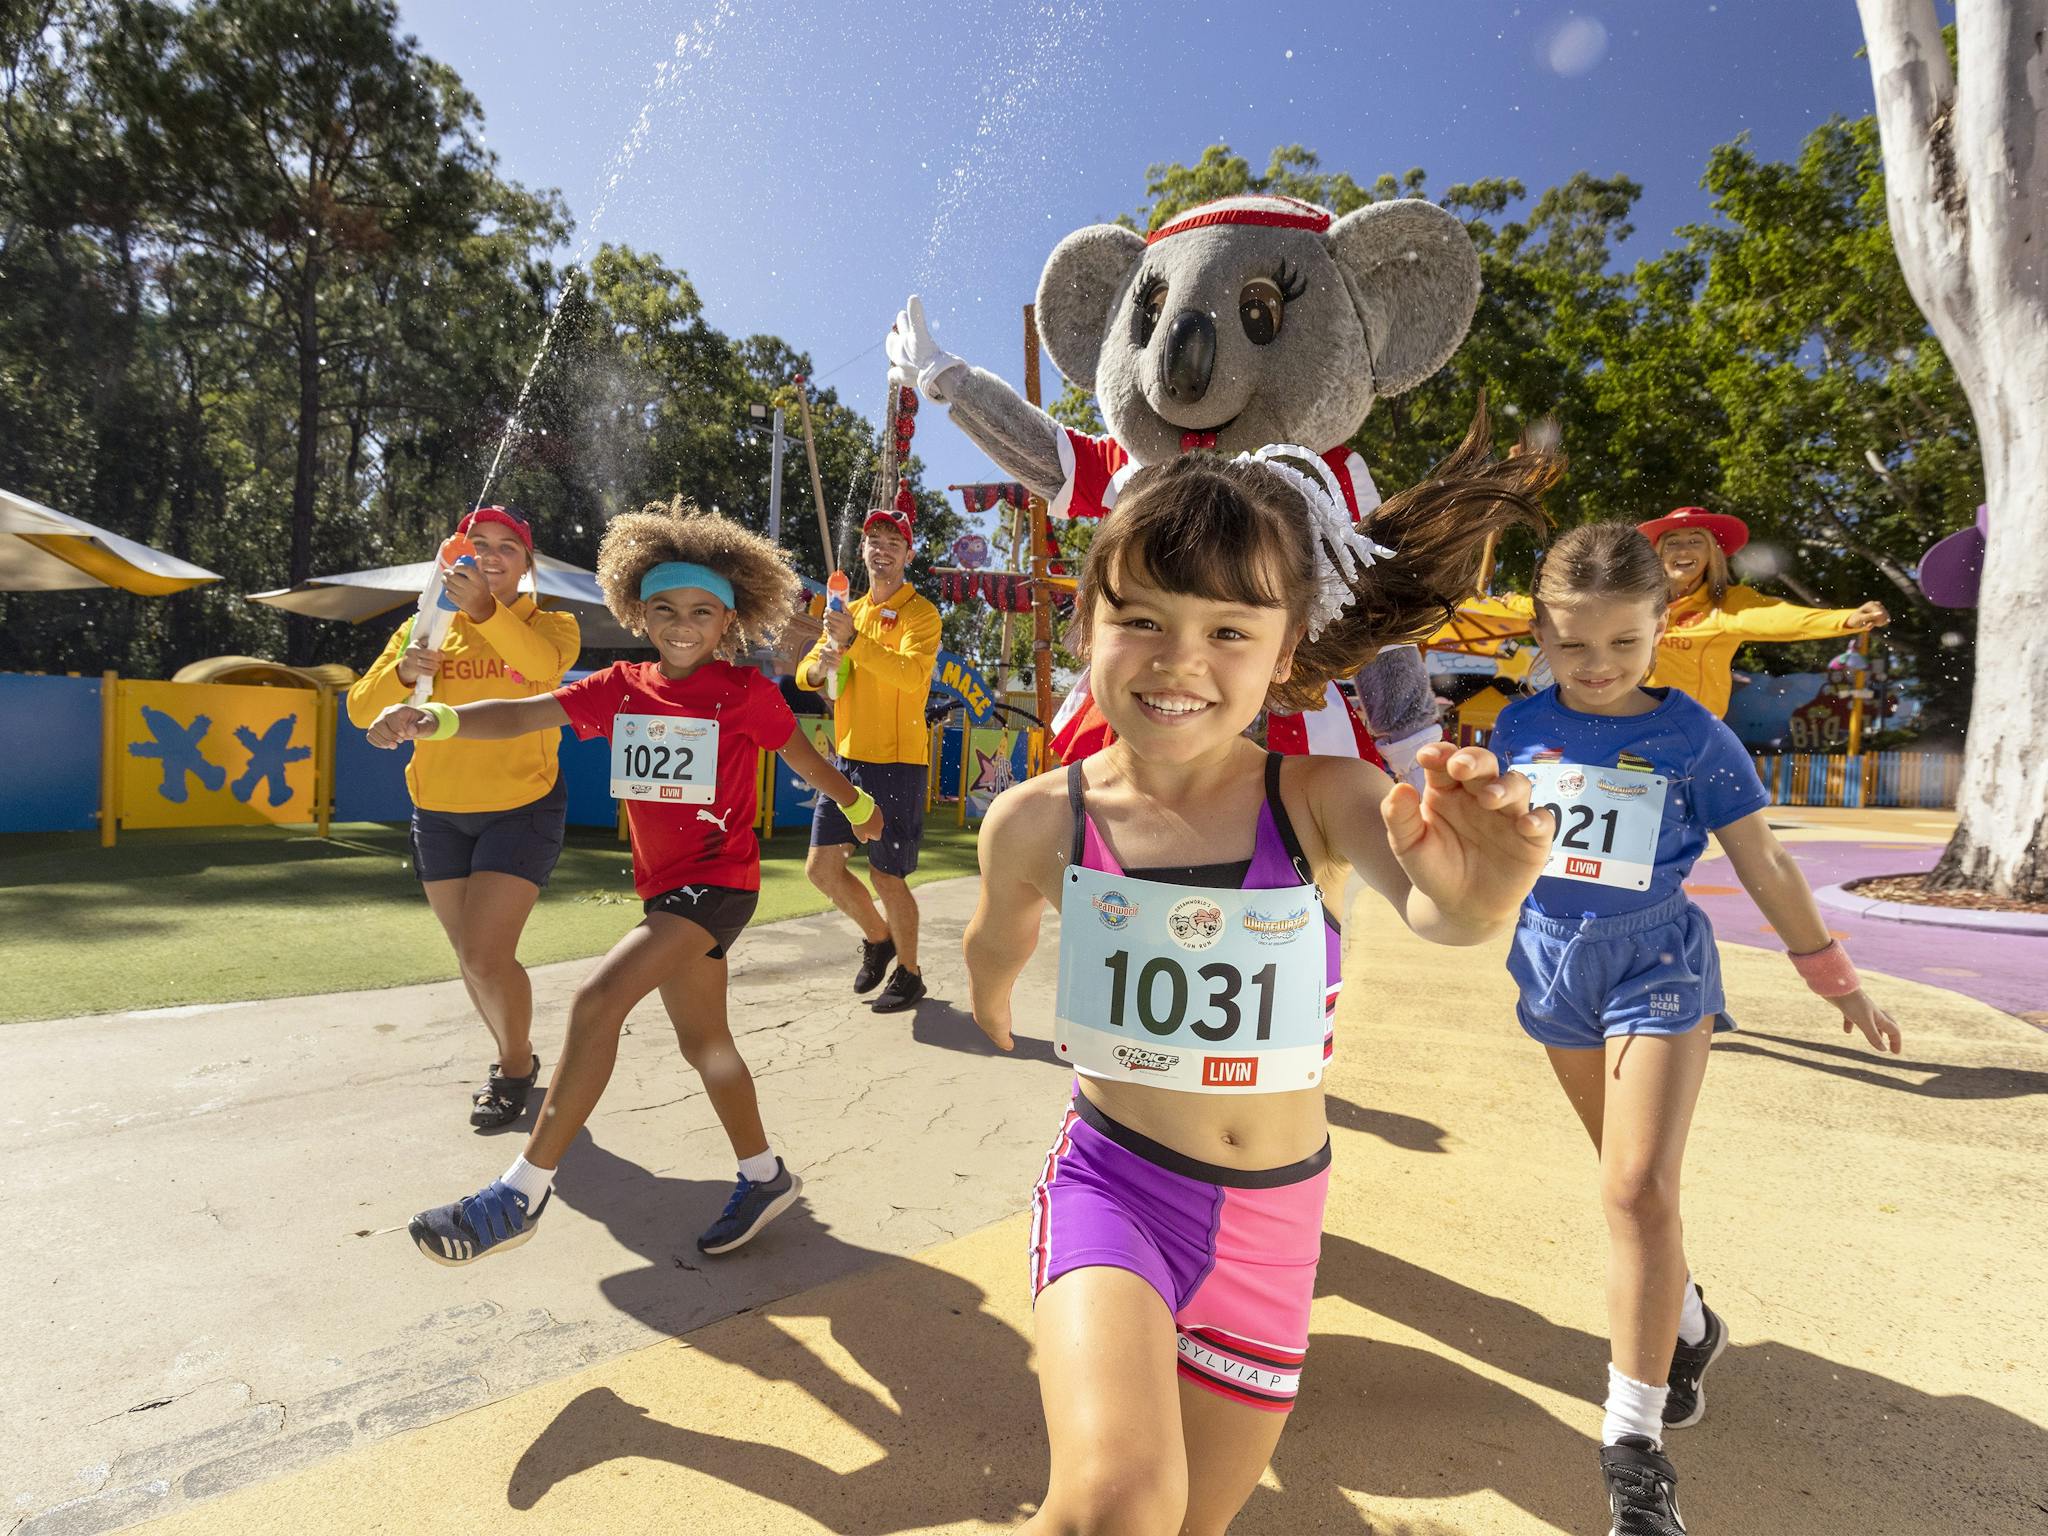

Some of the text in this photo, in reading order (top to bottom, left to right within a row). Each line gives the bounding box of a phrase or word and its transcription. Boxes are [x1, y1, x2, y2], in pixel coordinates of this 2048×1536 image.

[439, 659, 505, 680] EGUA
[942, 661, 991, 717] MAZE
[624, 744, 694, 780] 1022
[661, 787, 680, 797] LIVIN
[1569, 860, 1598, 875] LIVIN
[1199, 941, 1212, 949] RUN
[1104, 949, 1277, 1042] 1031
[1650, 993, 1680, 1003] BLUE
[1650, 1001, 1680, 1012] OCEAN
[1112, 1045, 1180, 1066] CHOICE
[1119, 1056, 1170, 1071] HOMES
[1209, 1062, 1252, 1082] LIVIN
[1178, 1337, 1281, 1388] SYLVIA P
